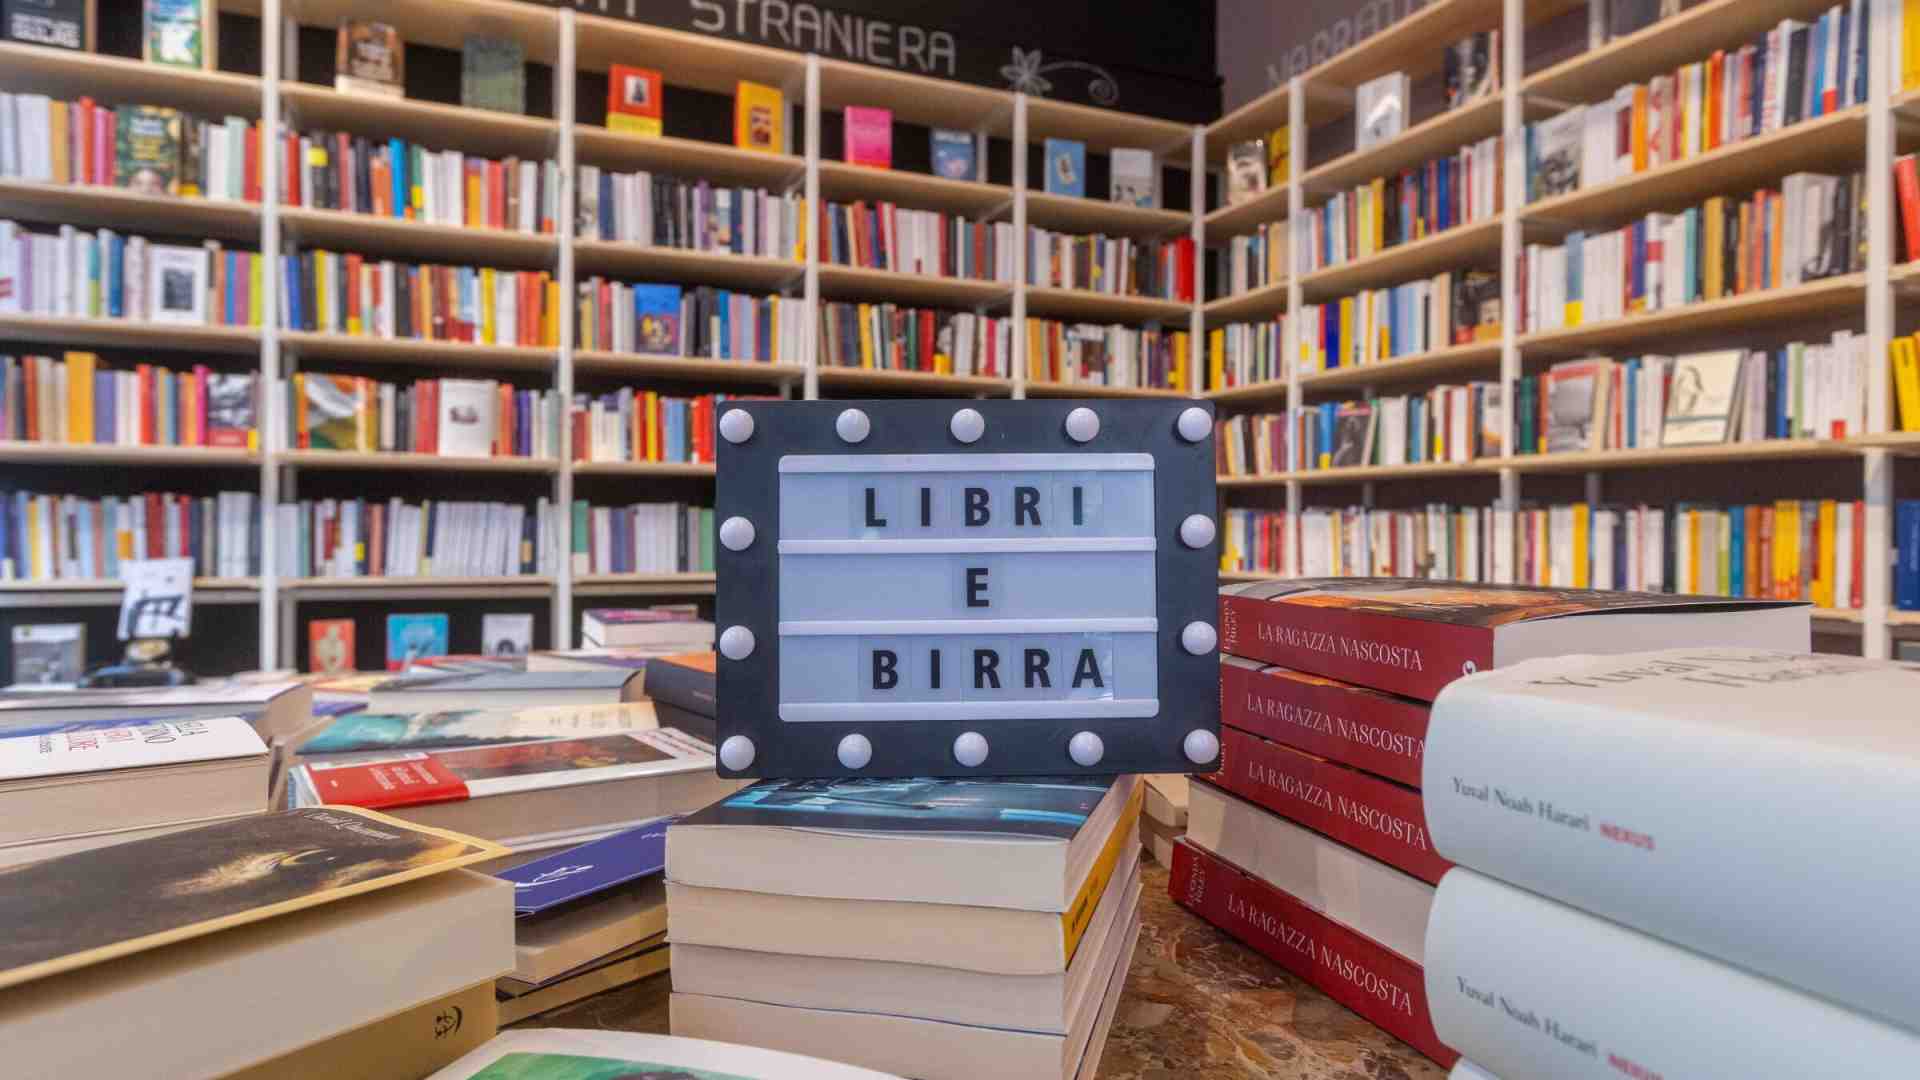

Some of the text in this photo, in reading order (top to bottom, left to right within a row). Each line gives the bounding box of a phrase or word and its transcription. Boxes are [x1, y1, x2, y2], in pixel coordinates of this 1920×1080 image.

[864, 486, 1084, 528] LIBRI
[965, 567, 991, 608] E
[872, 648, 1105, 690] BIRRA
[1257, 622, 1424, 673] LA RAGAZZA NASCOSTA
[1247, 693, 1264, 714] LA
[1266, 698, 1333, 735] RAGAZZA
[1336, 717, 1425, 759] NASCOSTA
[1248, 760, 1265, 783] LA
[1267, 767, 1334, 812] RAGAZZA
[1336, 796, 1427, 851] NASCOSTA
[1450, 776, 1488, 803] Yuval
[1494, 788, 1534, 816] Noah
[1538, 800, 1590, 832] Harari
[1227, 893, 1415, 1017] LA RAGAZZA NASCOSTA
[1456, 975, 1495, 1008] Yuval
[1500, 996, 1541, 1031] Noah
[1545, 1018, 1598, 1060] Harari
